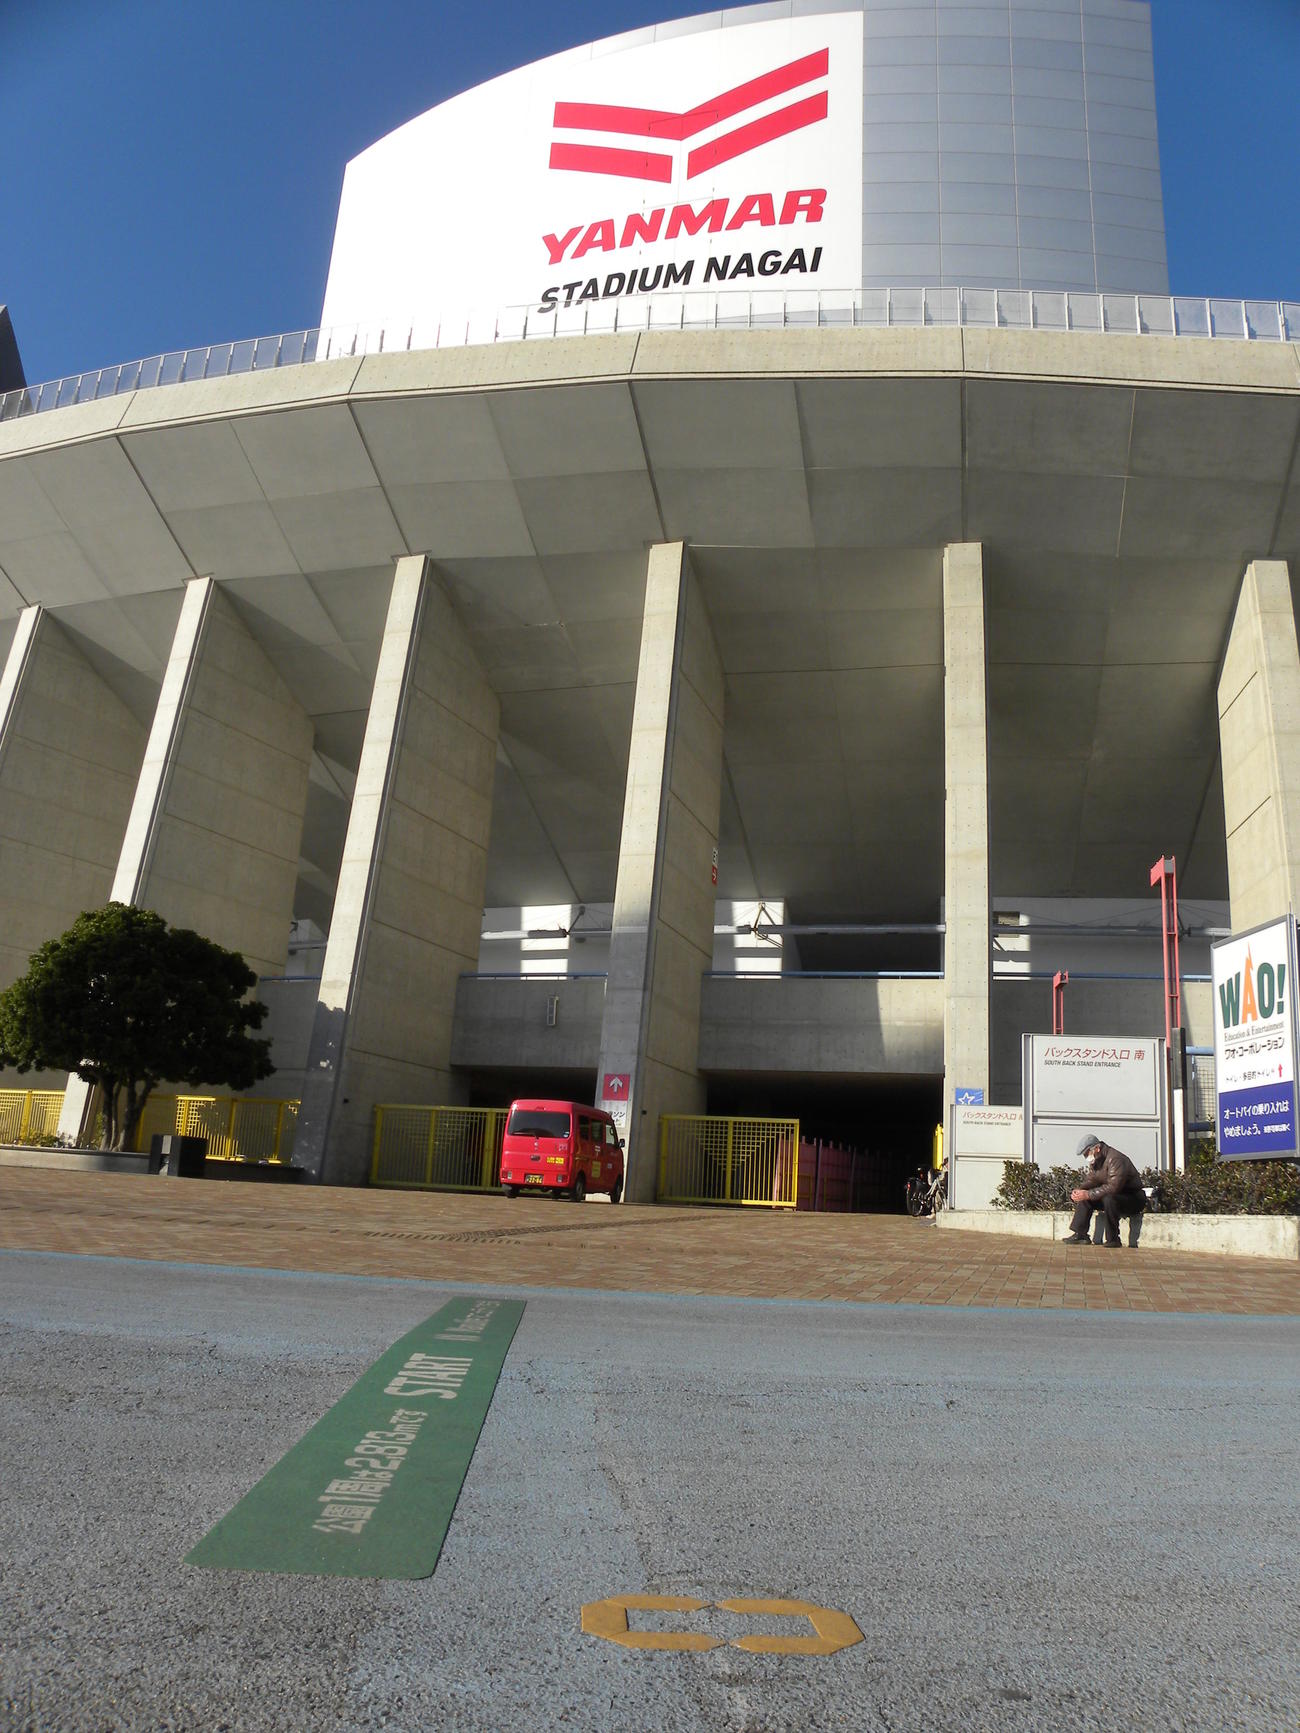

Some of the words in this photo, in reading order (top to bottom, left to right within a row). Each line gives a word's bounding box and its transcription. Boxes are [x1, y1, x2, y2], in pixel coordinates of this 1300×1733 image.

[542, 188, 827, 265] YANMAR
[537, 260, 695, 313] STADIUM
[703, 247, 823, 283] NAGAI
[1044, 1047, 1130, 1060] バックスタンド入口
[1134, 1050, 1145, 1060] 南
[1223, 1100, 1289, 1120] オートバイの乗り入れは
[384, 1353, 473, 1399] START
